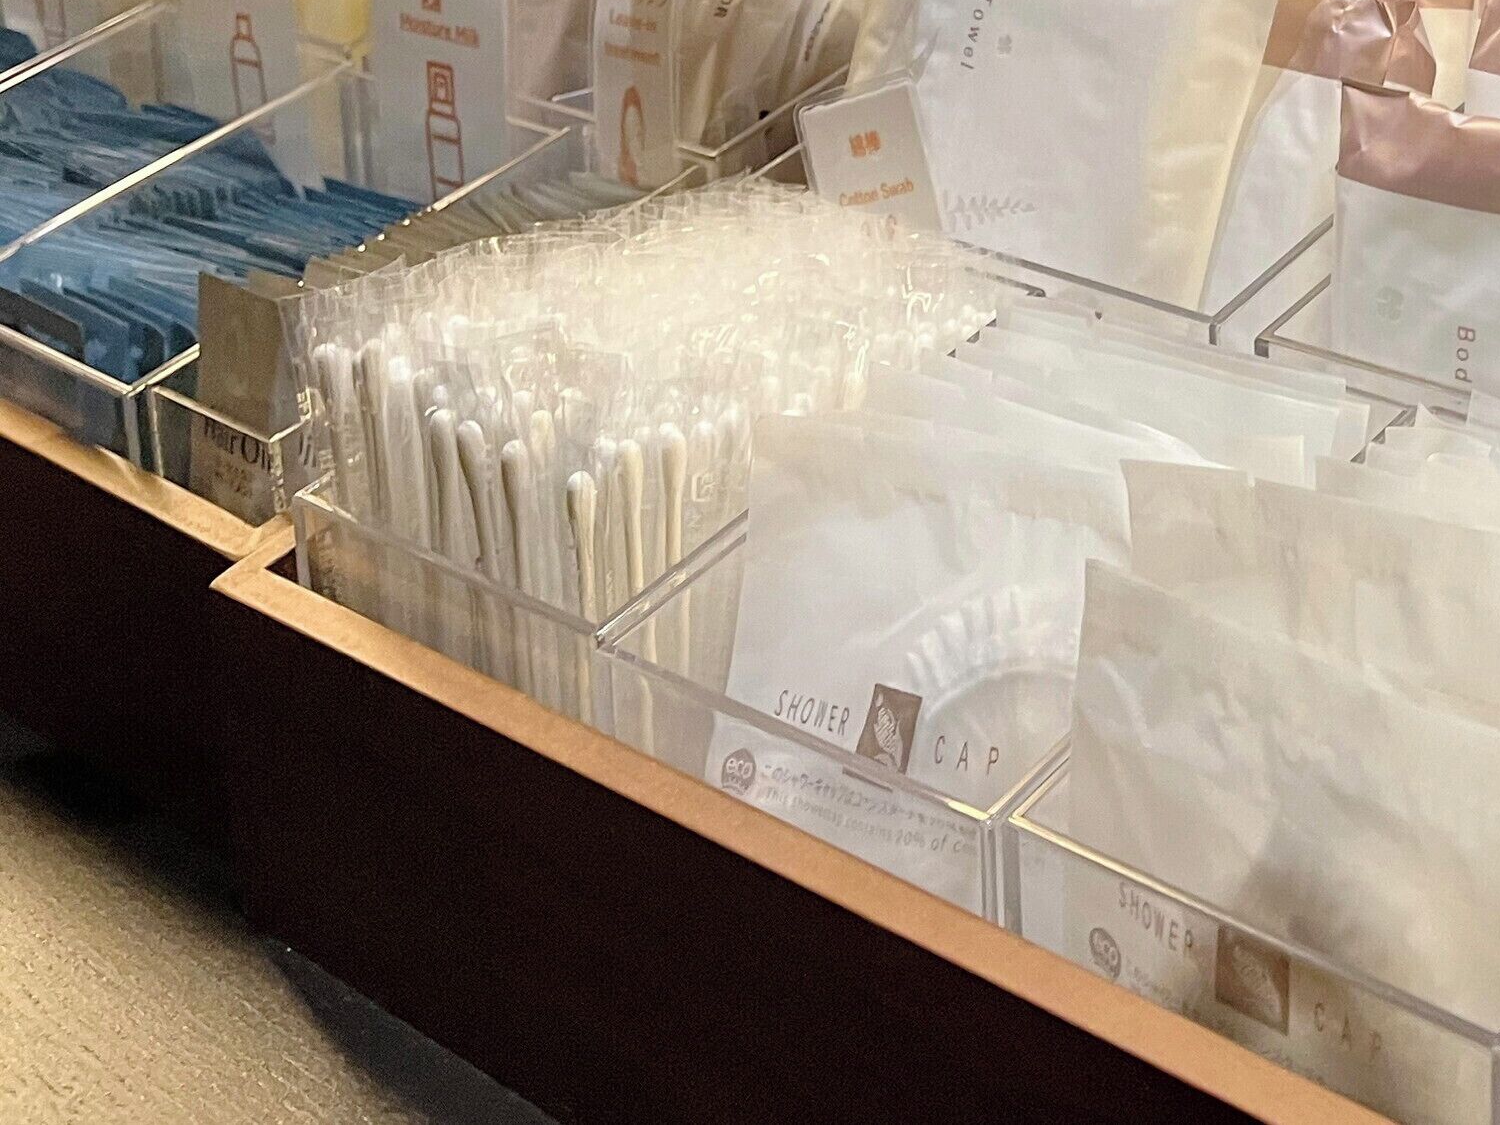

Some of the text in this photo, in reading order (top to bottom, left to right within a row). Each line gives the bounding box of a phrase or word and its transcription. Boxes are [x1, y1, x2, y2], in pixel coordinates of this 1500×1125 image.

[1455, 326, 1477, 386] Bod
[773, 688, 1000, 776] SHOWER CAP
[1118, 880, 1193, 955] SHOWER
